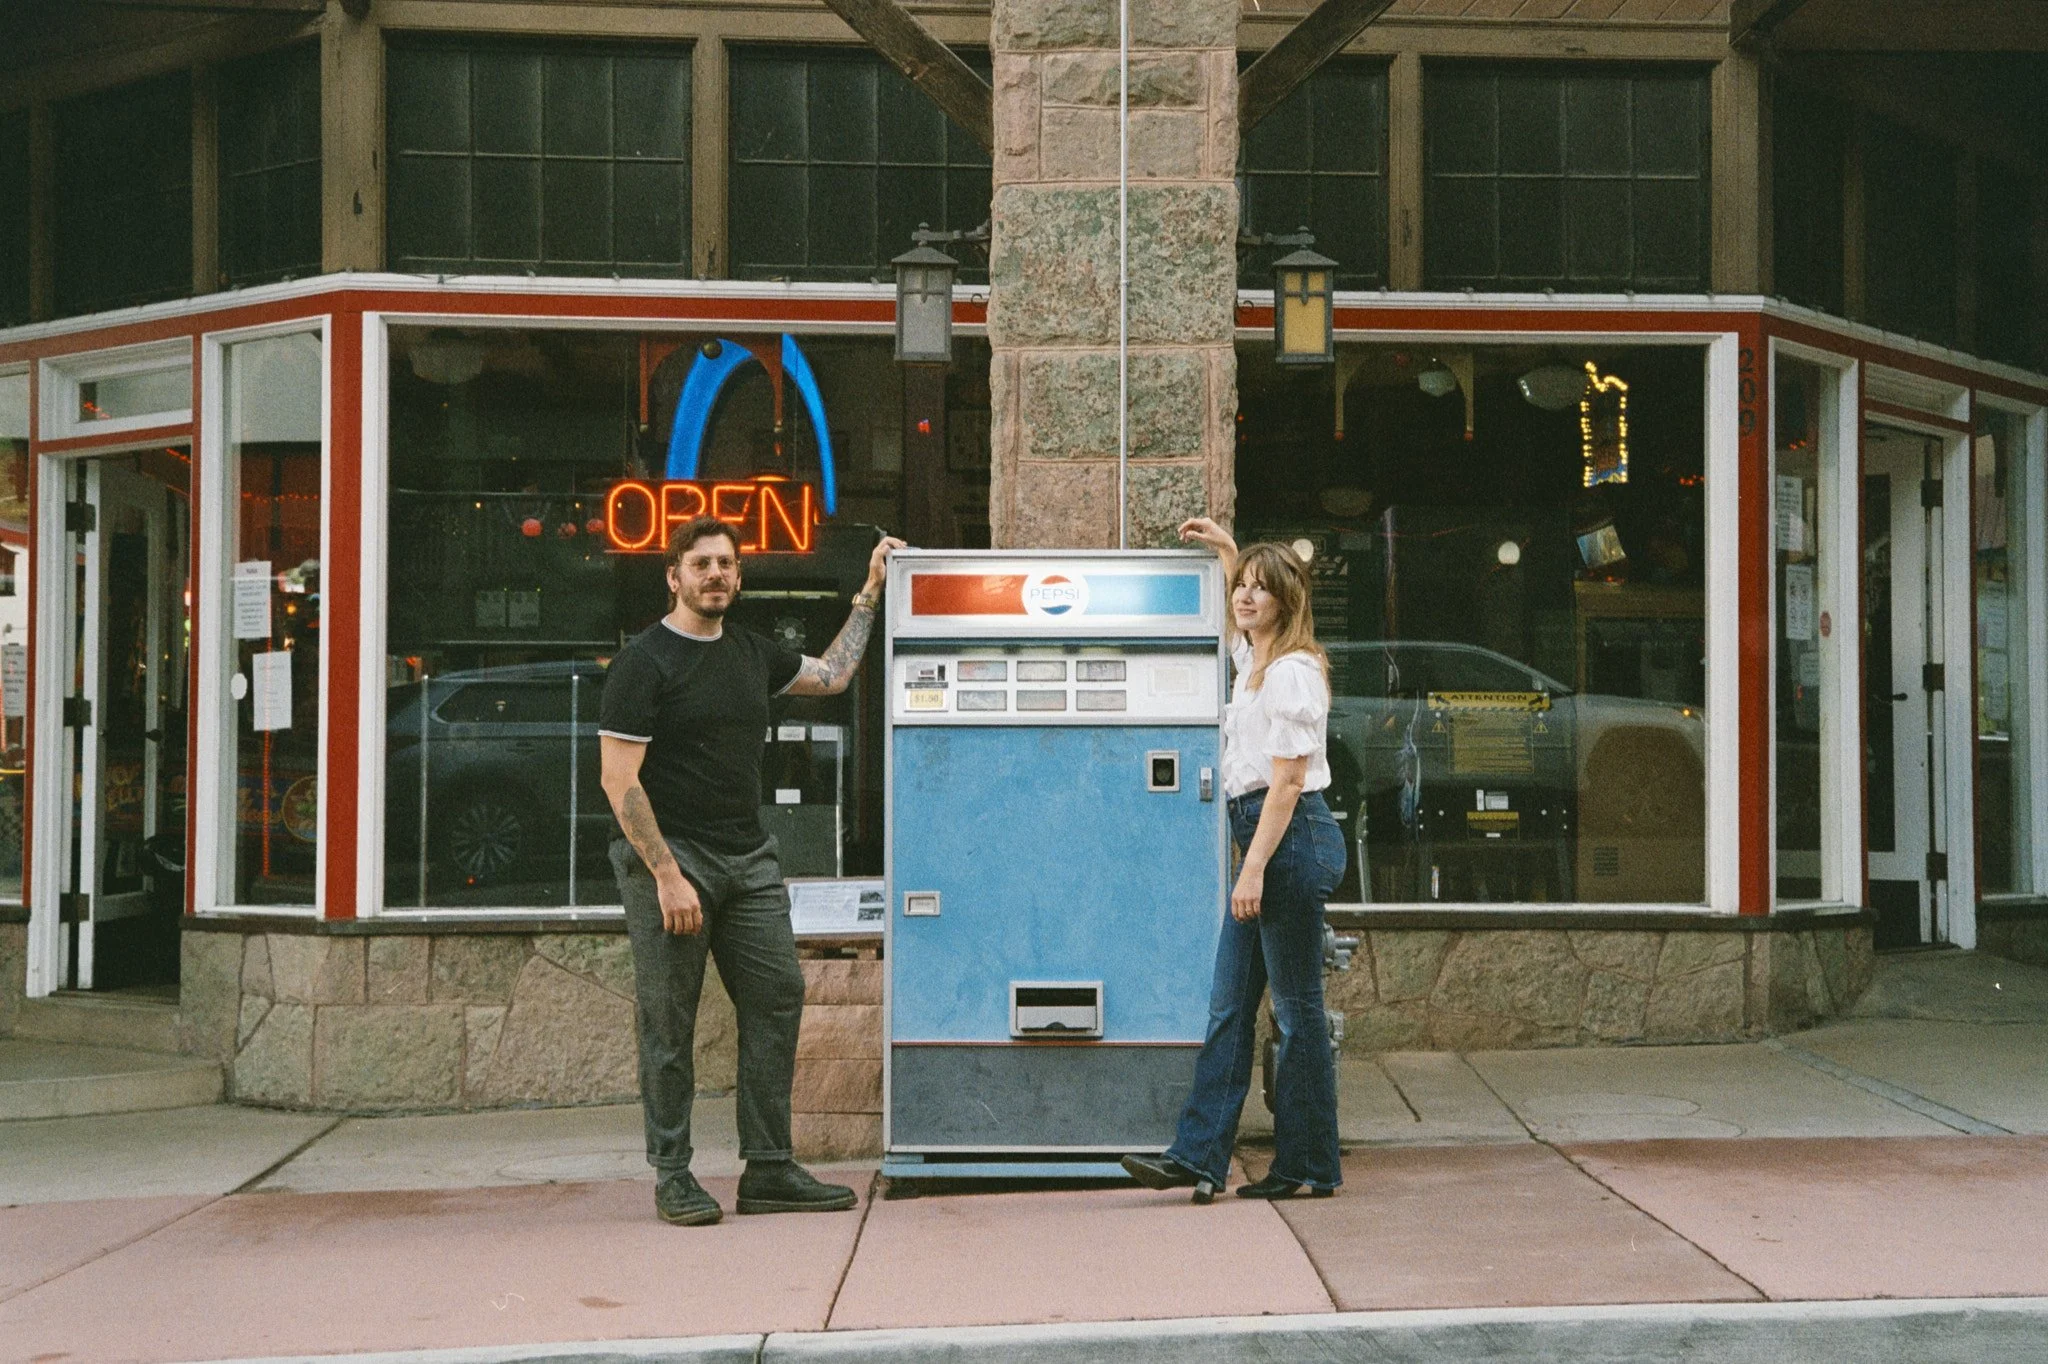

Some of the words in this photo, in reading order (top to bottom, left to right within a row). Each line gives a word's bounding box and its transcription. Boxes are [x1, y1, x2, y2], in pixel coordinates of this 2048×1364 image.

[606, 481, 812, 551] OPEN
[1030, 587, 1080, 601] PEPSI
[914, 694, 939, 704] $1.50
